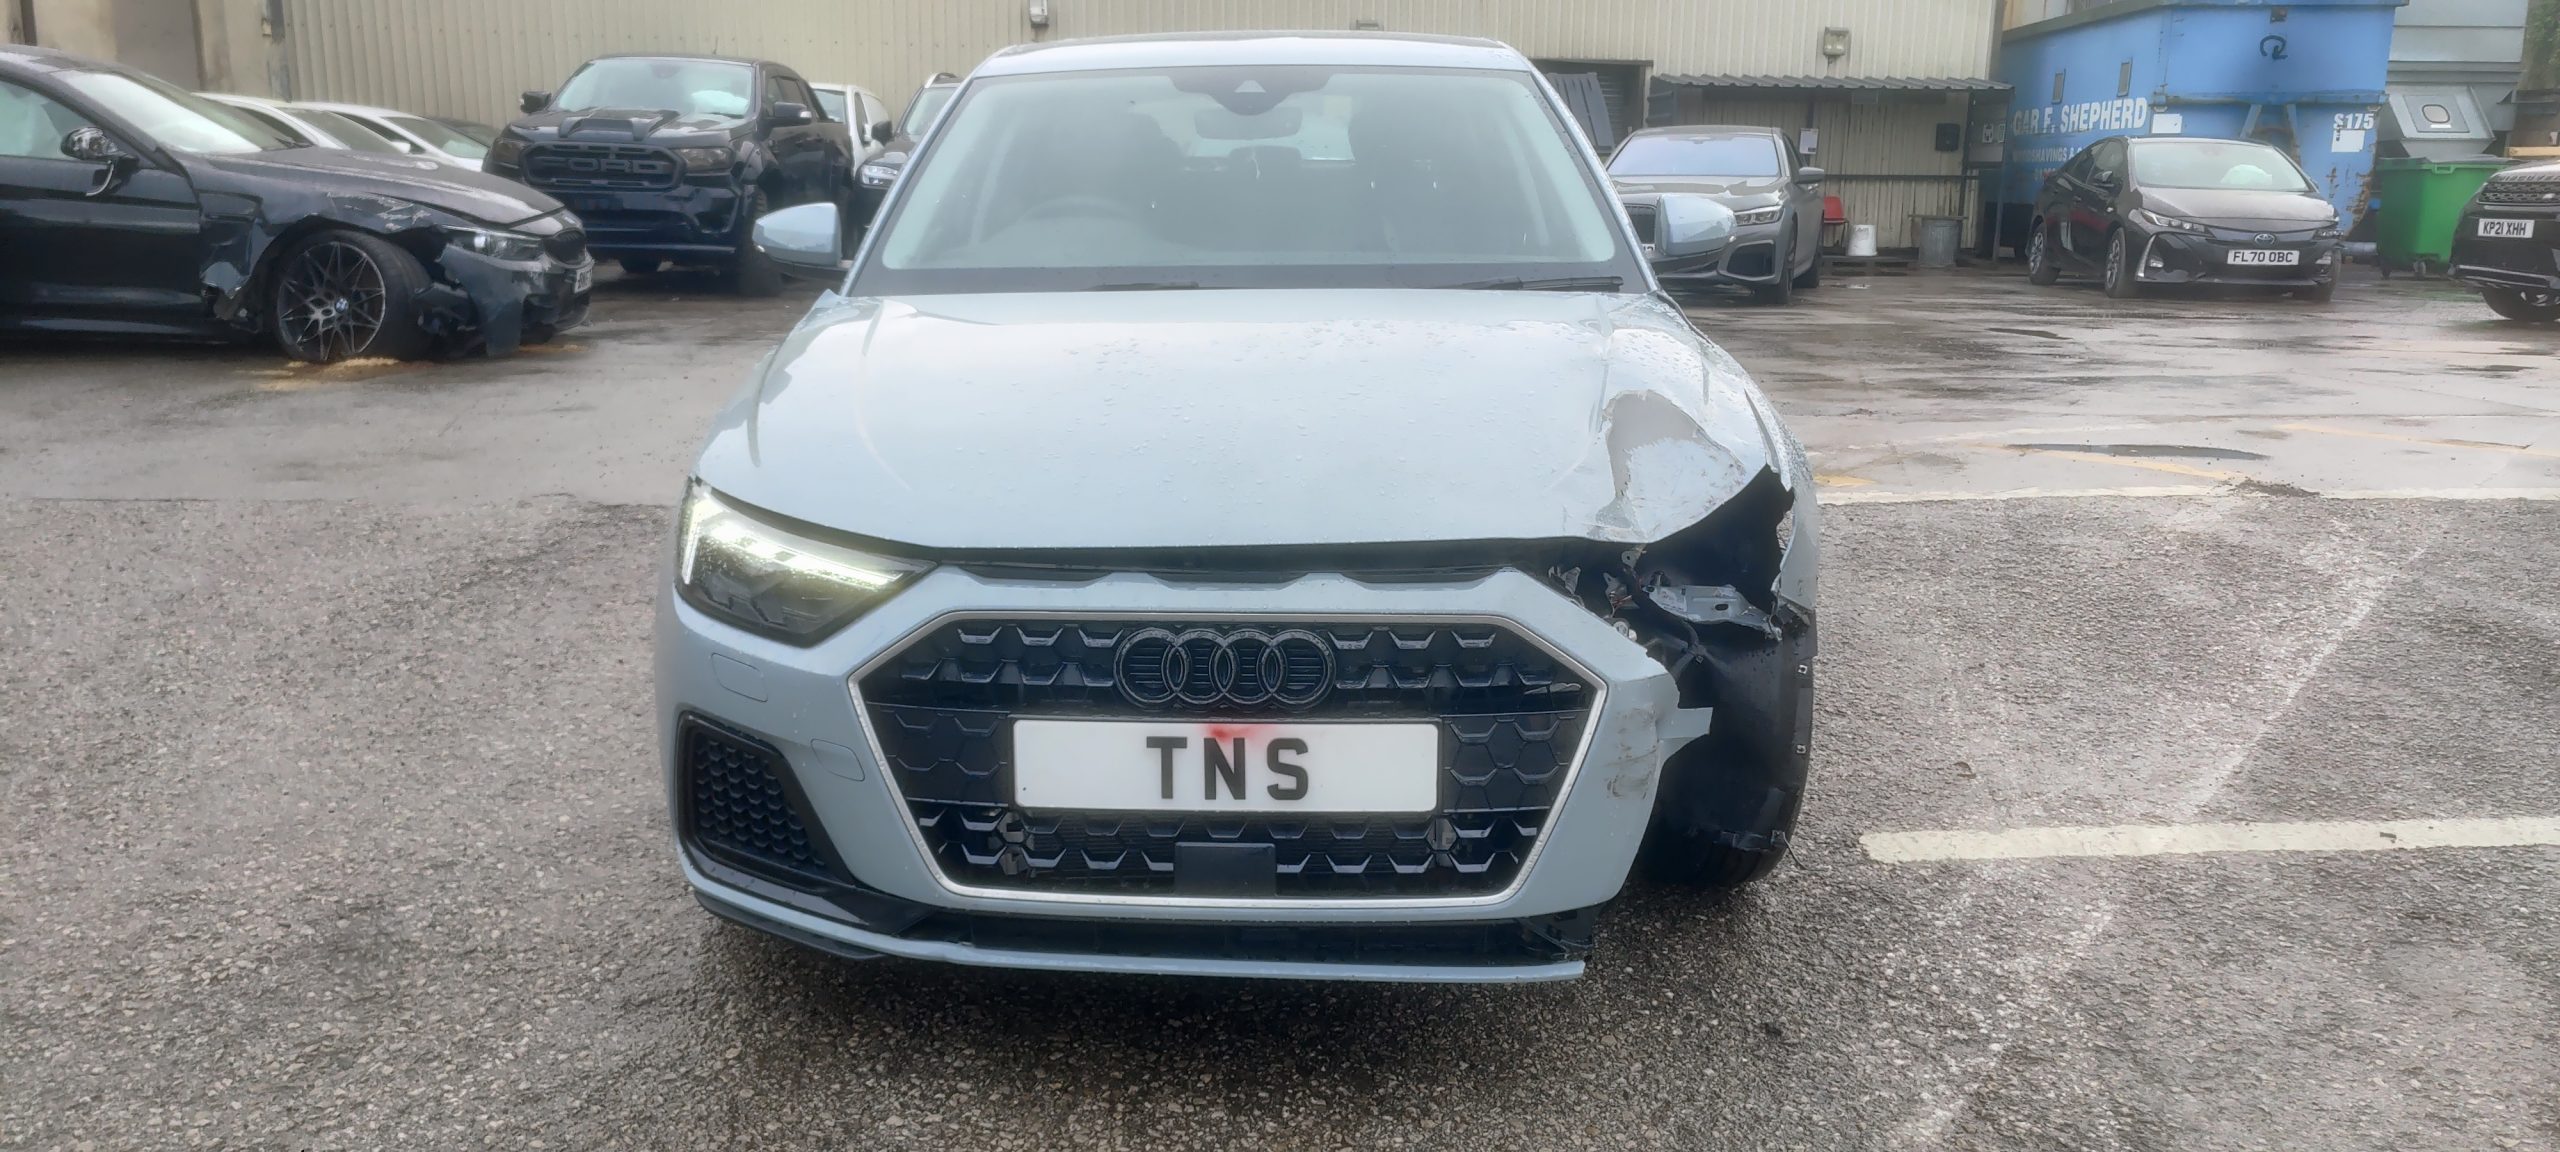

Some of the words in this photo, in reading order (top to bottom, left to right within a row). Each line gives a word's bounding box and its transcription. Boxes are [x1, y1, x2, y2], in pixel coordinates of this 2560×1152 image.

[2060, 97, 2147, 133] SHEPHERD
[539, 156, 662, 174] FORD
[2483, 222, 2504, 235] KP21
[2506, 222, 2527, 236] XHH
[2233, 251, 2265, 262] FL70
[2269, 252, 2293, 262] OBC
[1146, 736, 1309, 802] TNS
